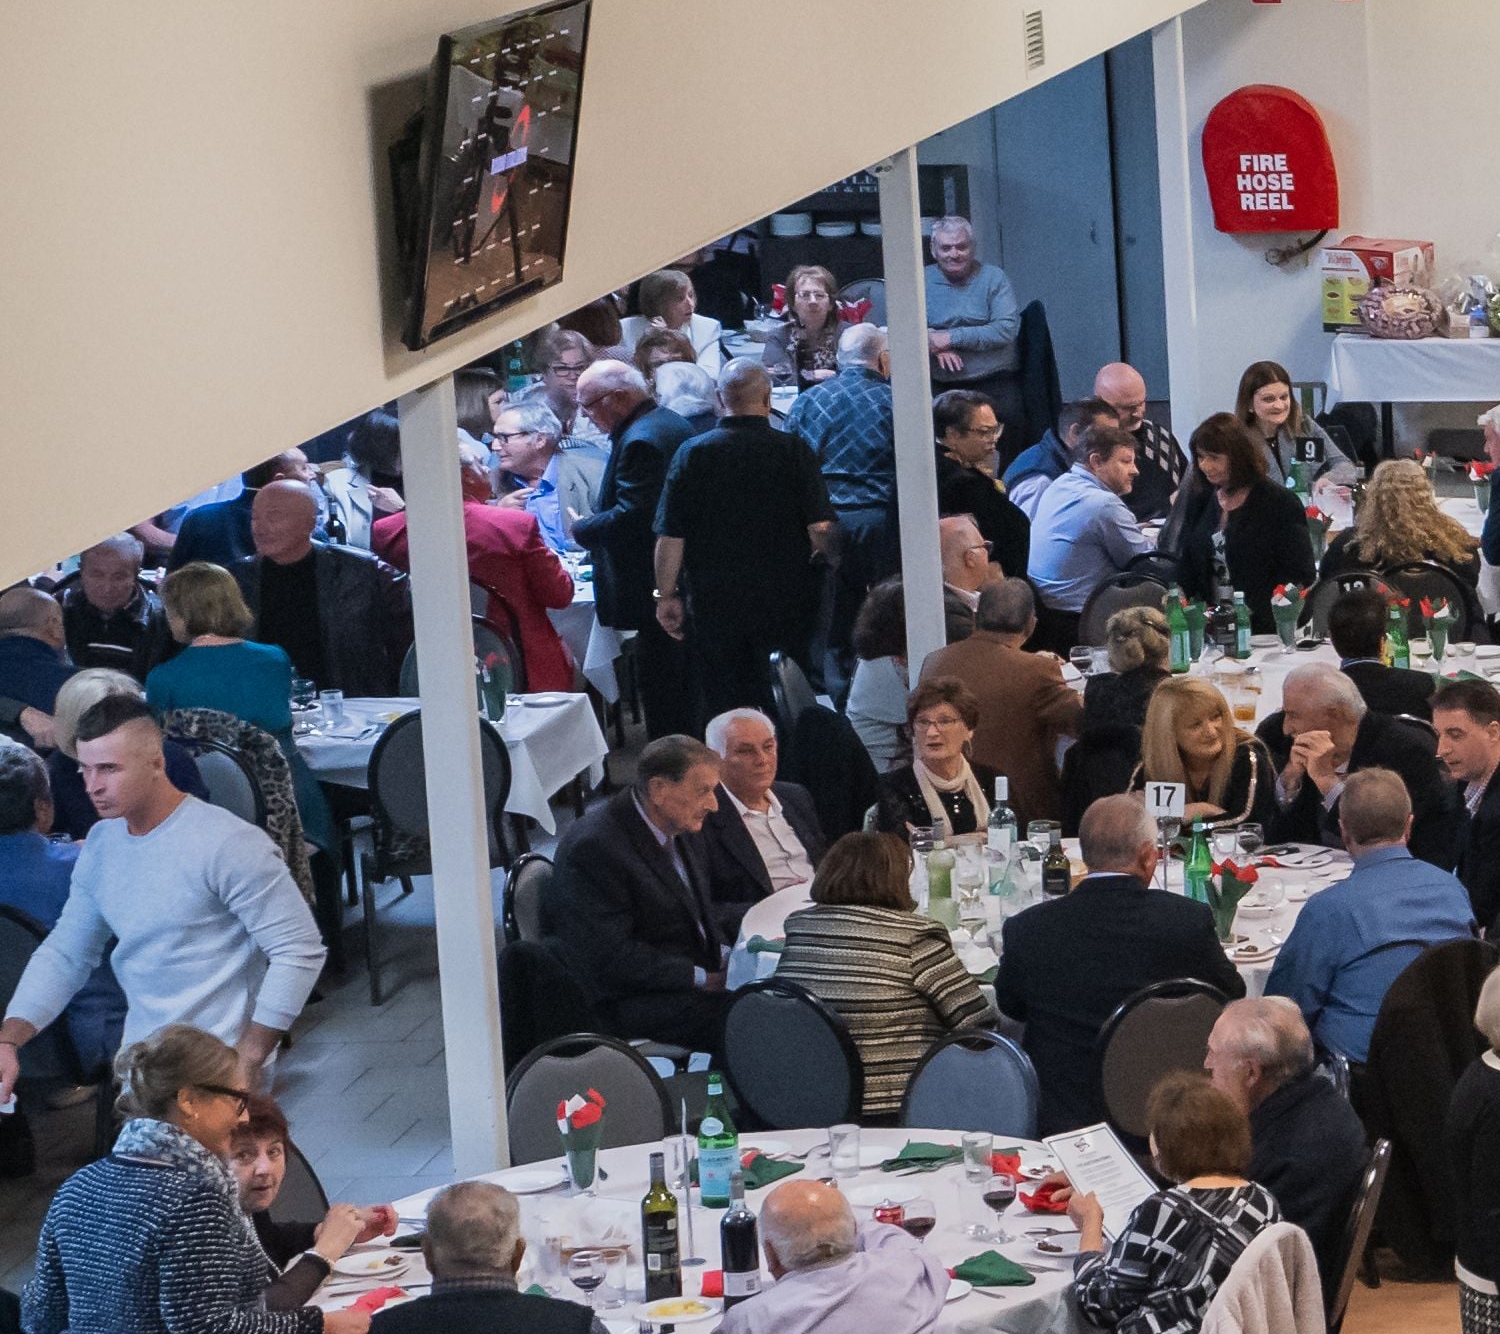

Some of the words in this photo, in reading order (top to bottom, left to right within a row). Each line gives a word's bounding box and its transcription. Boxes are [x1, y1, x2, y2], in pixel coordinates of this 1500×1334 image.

[1239, 154, 1287, 172] FIRE
[1237, 173, 1295, 191] HOSE
[1240, 192, 1294, 211] REEL
[1304, 439, 1317, 461] 9
[1151, 785, 1176, 808] 17
